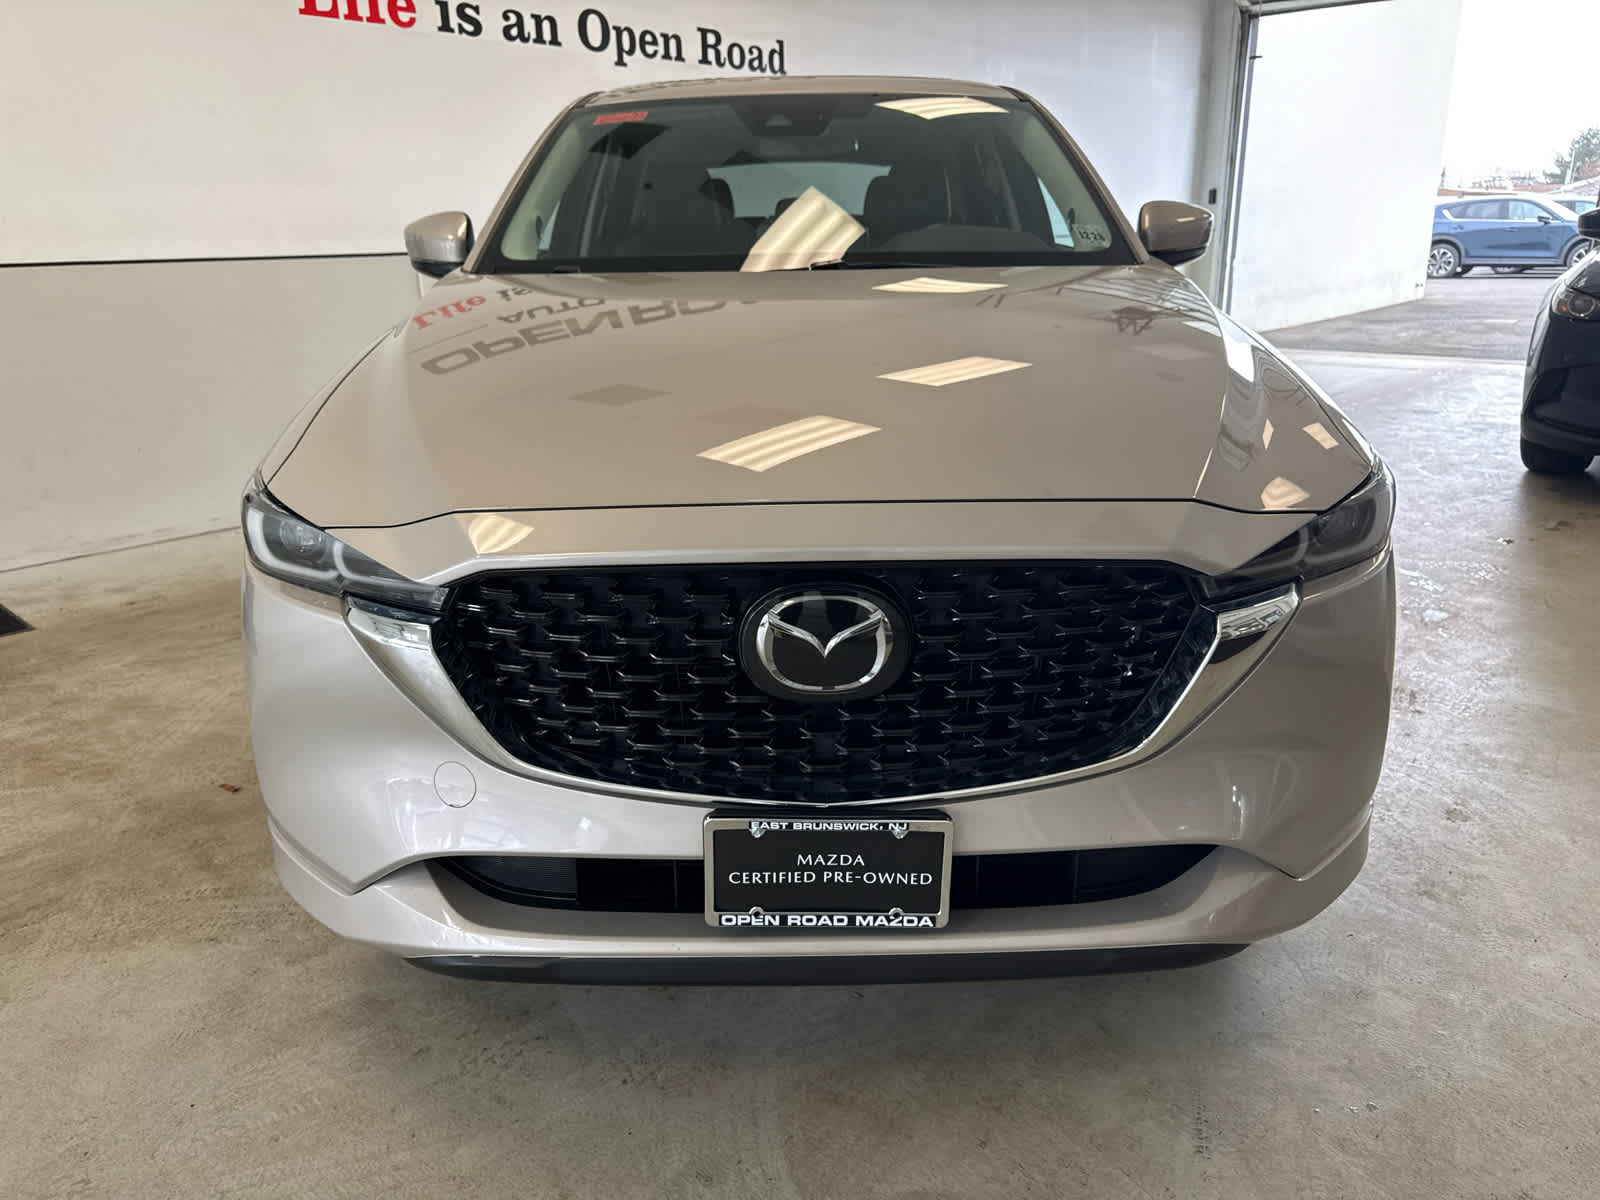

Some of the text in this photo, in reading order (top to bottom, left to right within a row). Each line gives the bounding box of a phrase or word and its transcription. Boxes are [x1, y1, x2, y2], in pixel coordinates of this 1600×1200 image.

[502, 9, 562, 47] an
[577, 8, 686, 67] Open
[697, 27, 787, 75] Road
[751, 821, 908, 832] EAST BRUNSWICK, NJ
[797, 854, 865, 867] MAZDA
[728, 871, 934, 886] CERTIFIED PRE-OWNED
[721, 914, 934, 928] OPEN ROAD MAZDA
